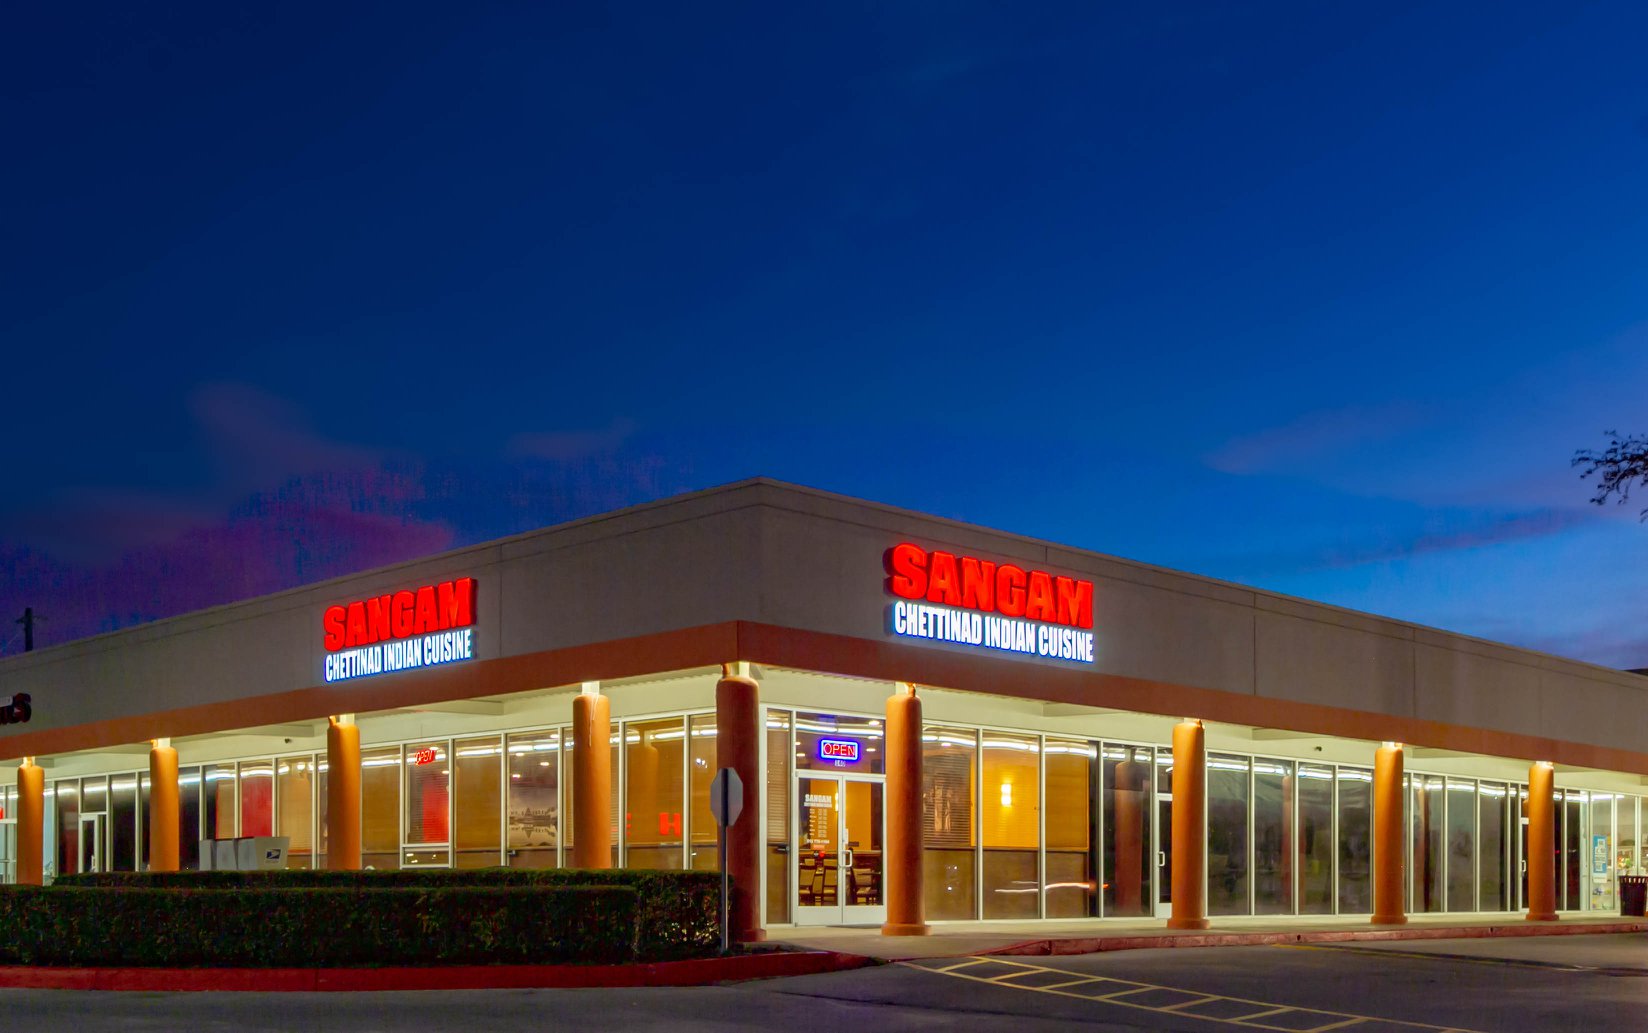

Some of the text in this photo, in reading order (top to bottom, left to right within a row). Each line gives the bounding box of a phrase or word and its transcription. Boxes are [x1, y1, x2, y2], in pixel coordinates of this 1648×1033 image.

[324, 577, 474, 652] SANGAM
[889, 543, 1093, 629] SANGAM
[325, 629, 472, 682] CHETTINAD INDIAN CUISINE
[894, 601, 1094, 662] CHETTINAD INDIAN CUISINE
[823, 743, 855, 756] OPEN
